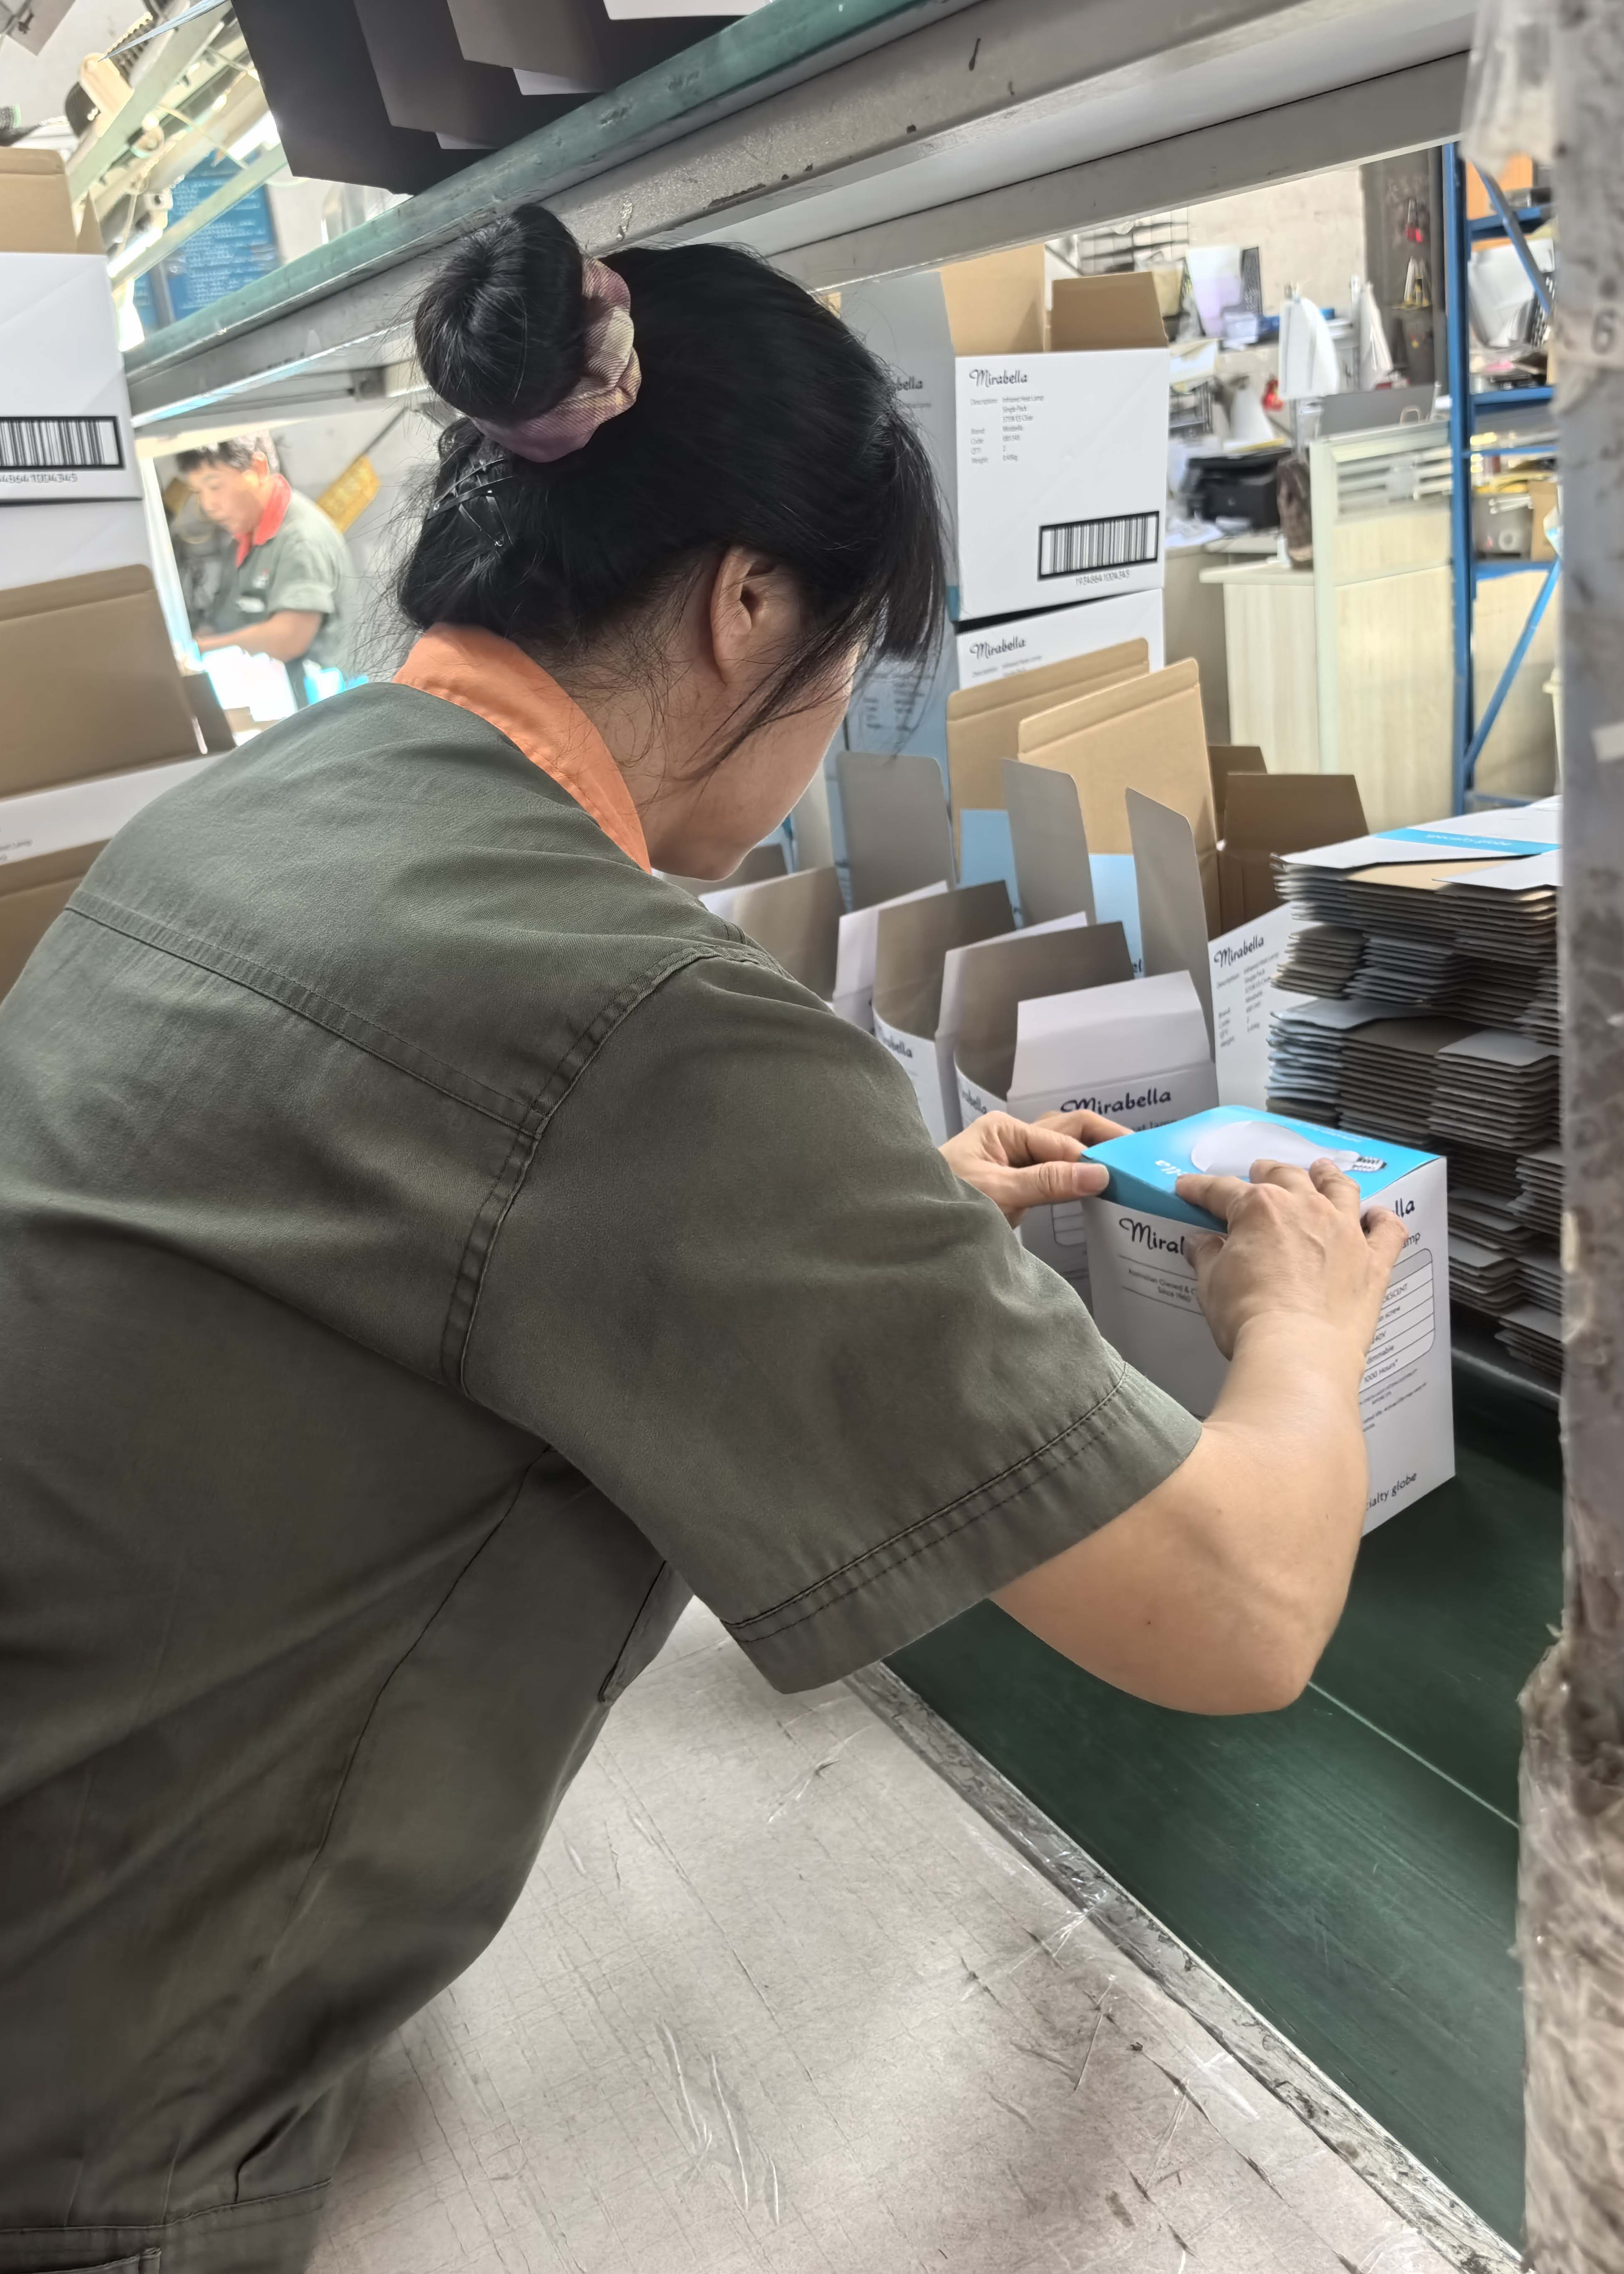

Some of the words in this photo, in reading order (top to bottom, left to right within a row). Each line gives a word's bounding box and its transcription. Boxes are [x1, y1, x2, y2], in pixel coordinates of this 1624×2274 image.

[969, 369, 1028, 388] Mirabella
[969, 635, 1026, 660] Mirabella
[1214, 935, 1264, 968] Mirabella
[1060, 1087, 1171, 1115] Mirabella
[1391, 1473, 1417, 1497] globe
